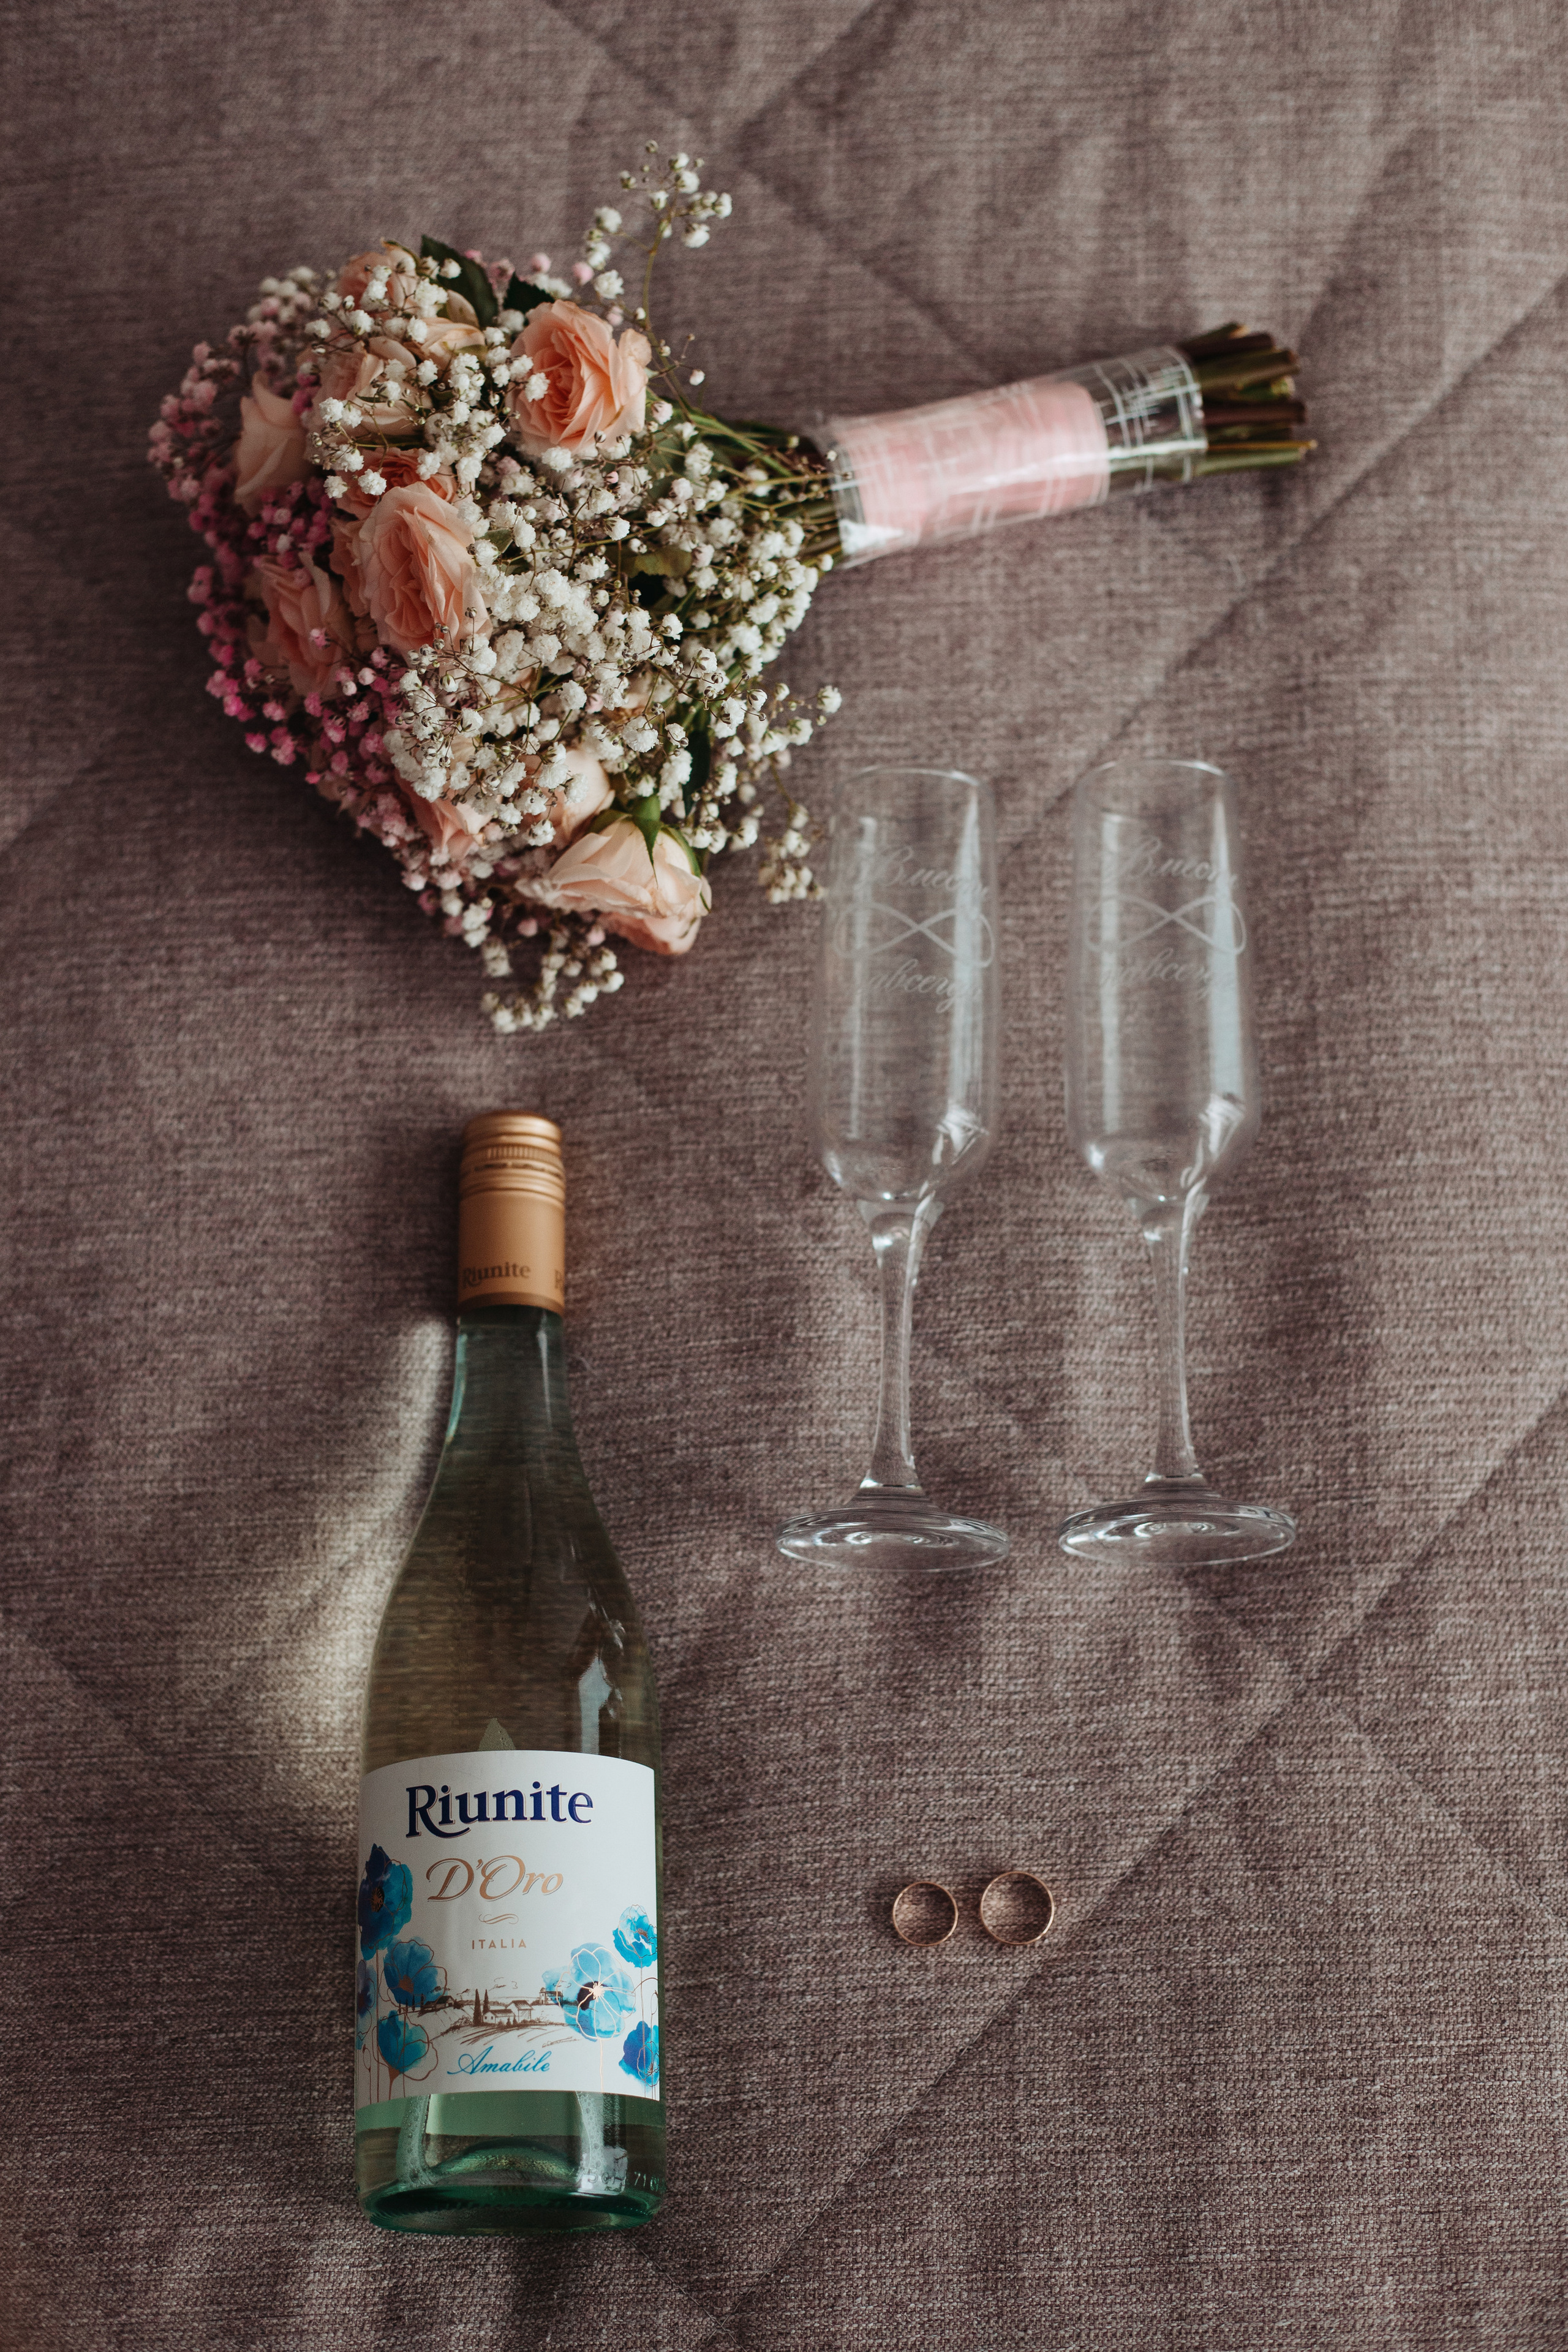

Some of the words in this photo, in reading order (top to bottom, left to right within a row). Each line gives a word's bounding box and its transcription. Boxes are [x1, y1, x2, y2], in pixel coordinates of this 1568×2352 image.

[462, 1262, 531, 1289] Riunite
[405, 1781, 595, 1839] Riunite
[426, 1855, 564, 1902] D'Oro
[472, 1939, 527, 1950] ITALIA
[447, 2045, 552, 2075] Amabile
